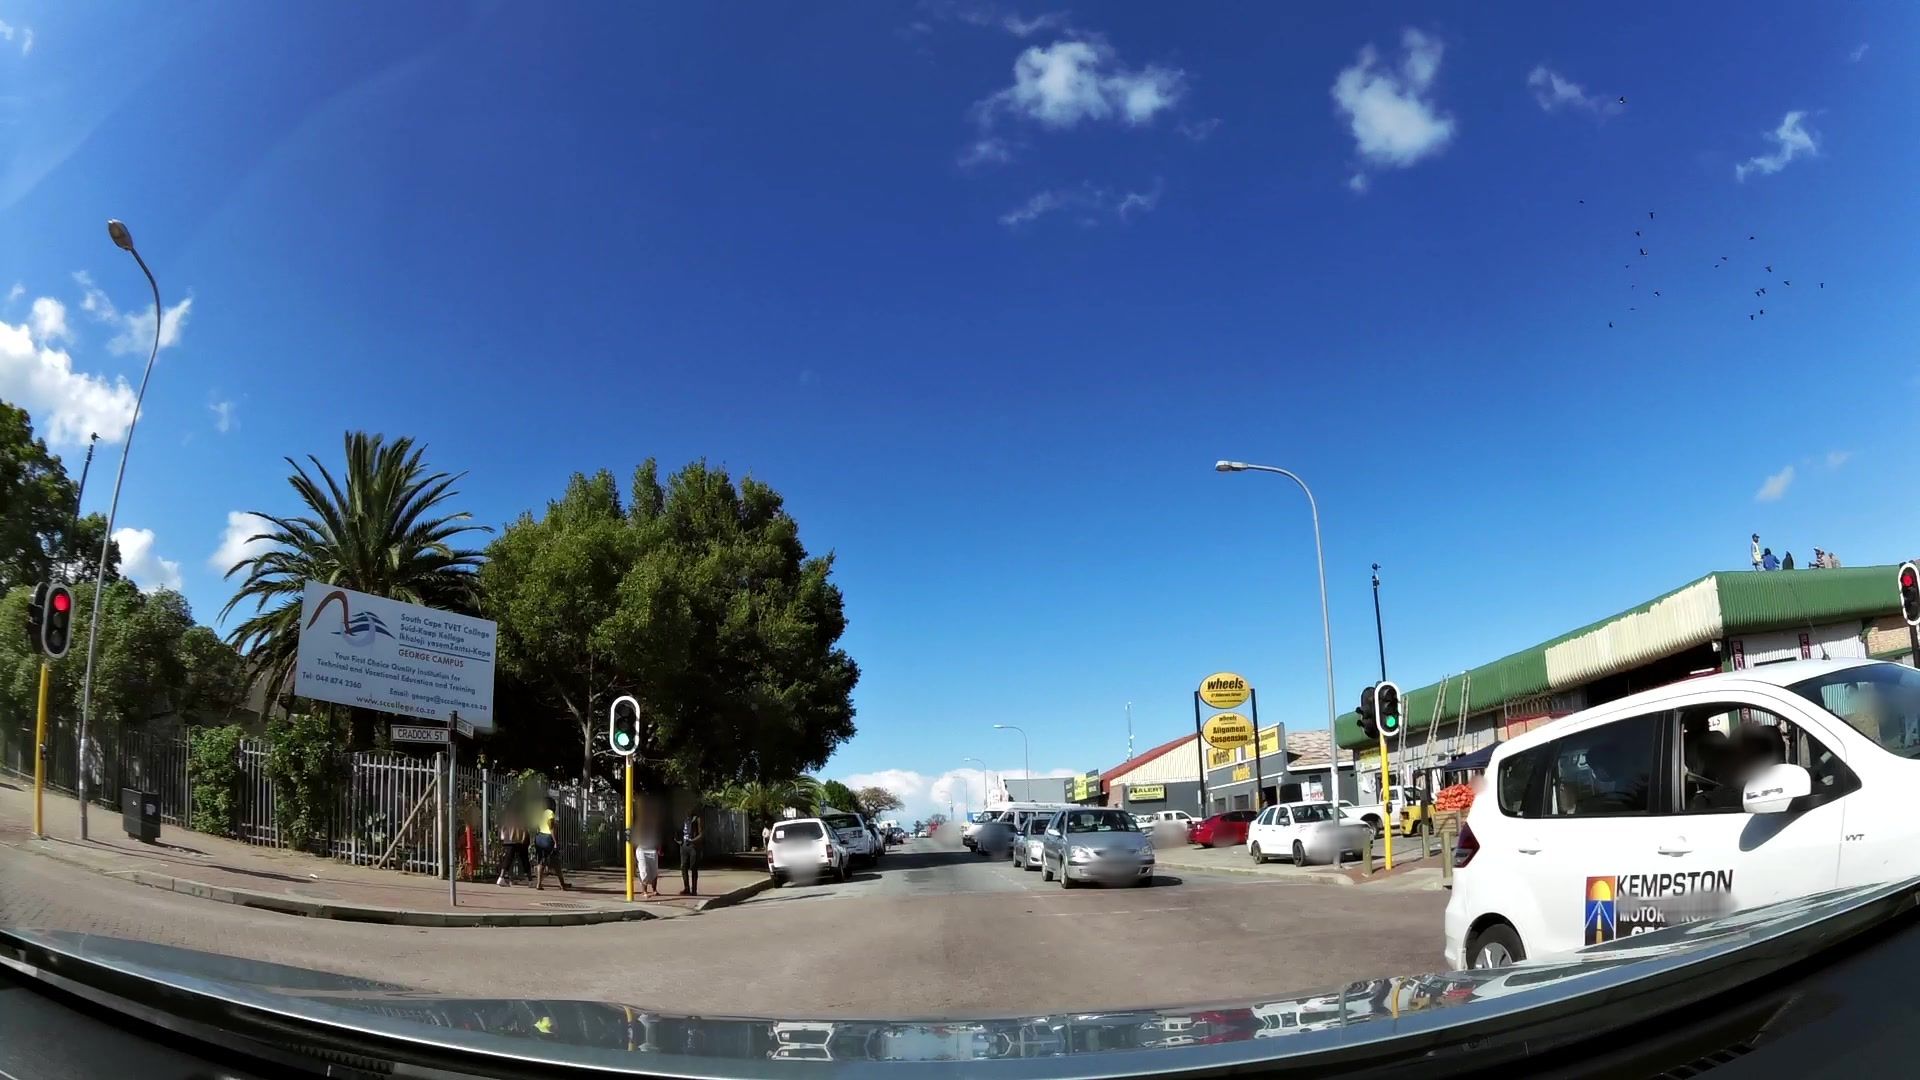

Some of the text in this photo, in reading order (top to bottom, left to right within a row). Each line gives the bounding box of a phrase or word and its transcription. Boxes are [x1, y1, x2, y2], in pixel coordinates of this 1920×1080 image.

[401, 613, 490, 638] South Cape TVET College
[401, 624, 465, 643] Suid-Kaap Kollege
[335, 652, 350, 660] Your
[352, 655, 366, 664] First
[368, 658, 389, 668] Choice
[391, 663, 416, 674] Quality
[418, 668, 449, 680] Institution
[398, 649, 464, 667] GEORGE CAMPUS
[316, 674, 329, 683] 044
[317, 658, 348, 671] Technical
[350, 666, 362, 674] and
[365, 668, 399, 680] Vocational
[401, 674, 433, 687] Education
[449, 683, 476, 695] Training
[1207, 677, 1244, 690] wheels
[356, 696, 436, 715] www.sccollege.co.za
[397, 728, 444, 740] CRADOCK ST
[1211, 734, 1248, 743] Suspension
[1213, 726, 1246, 735] Alignment
[1845, 833, 1865, 841] VVT
[1616, 869, 1733, 898] KEMPSTON
